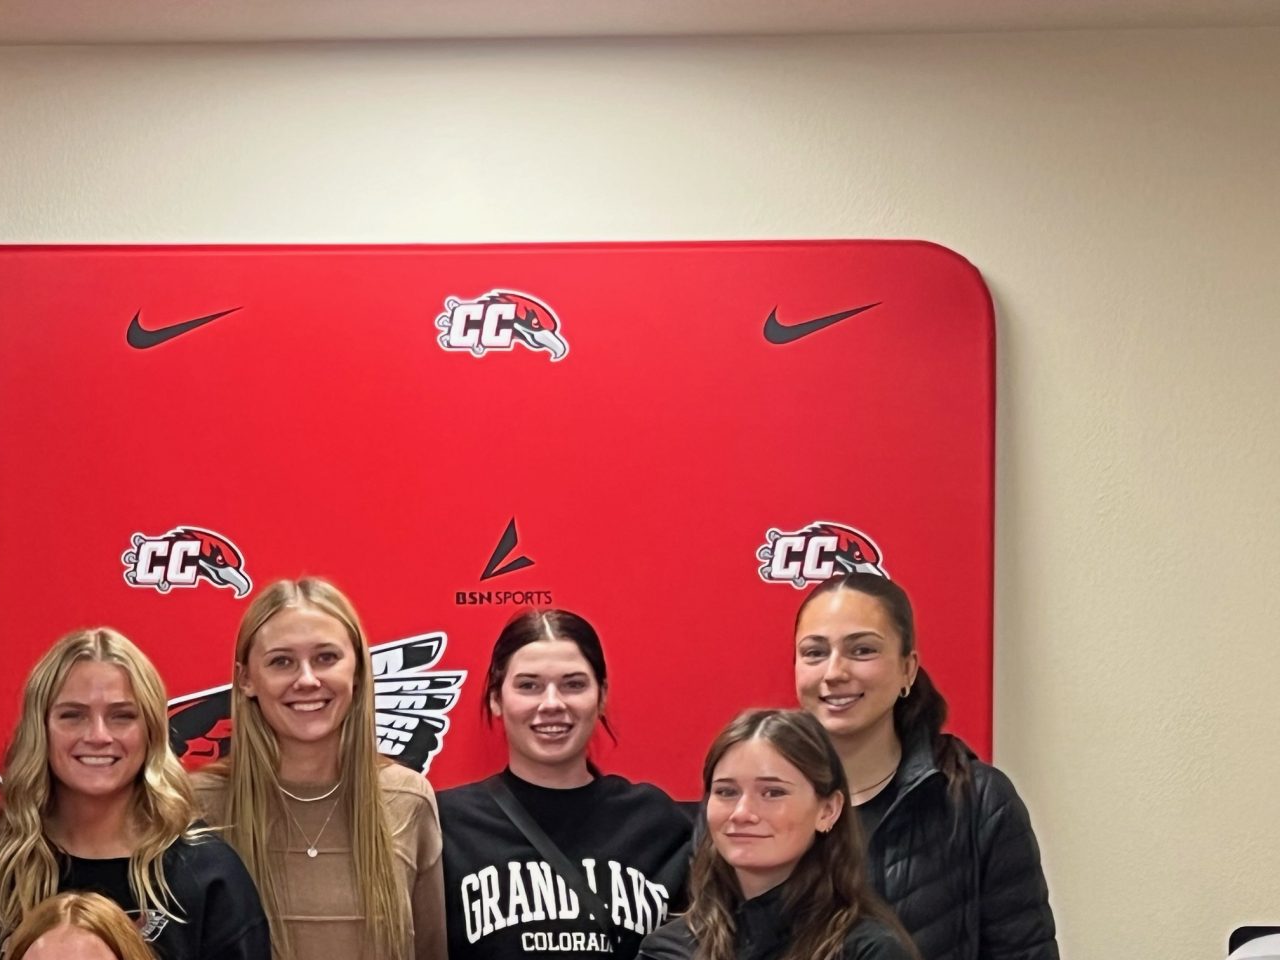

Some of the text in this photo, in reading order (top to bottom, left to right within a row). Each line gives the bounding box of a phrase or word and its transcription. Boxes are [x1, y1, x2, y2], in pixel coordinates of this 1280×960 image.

[449, 303, 517, 347] CC
[135, 540, 201, 583] CC
[770, 536, 838, 579] CC
[455, 590, 553, 605] BSN SPORTS
[461, 861, 580, 944] GRAND
